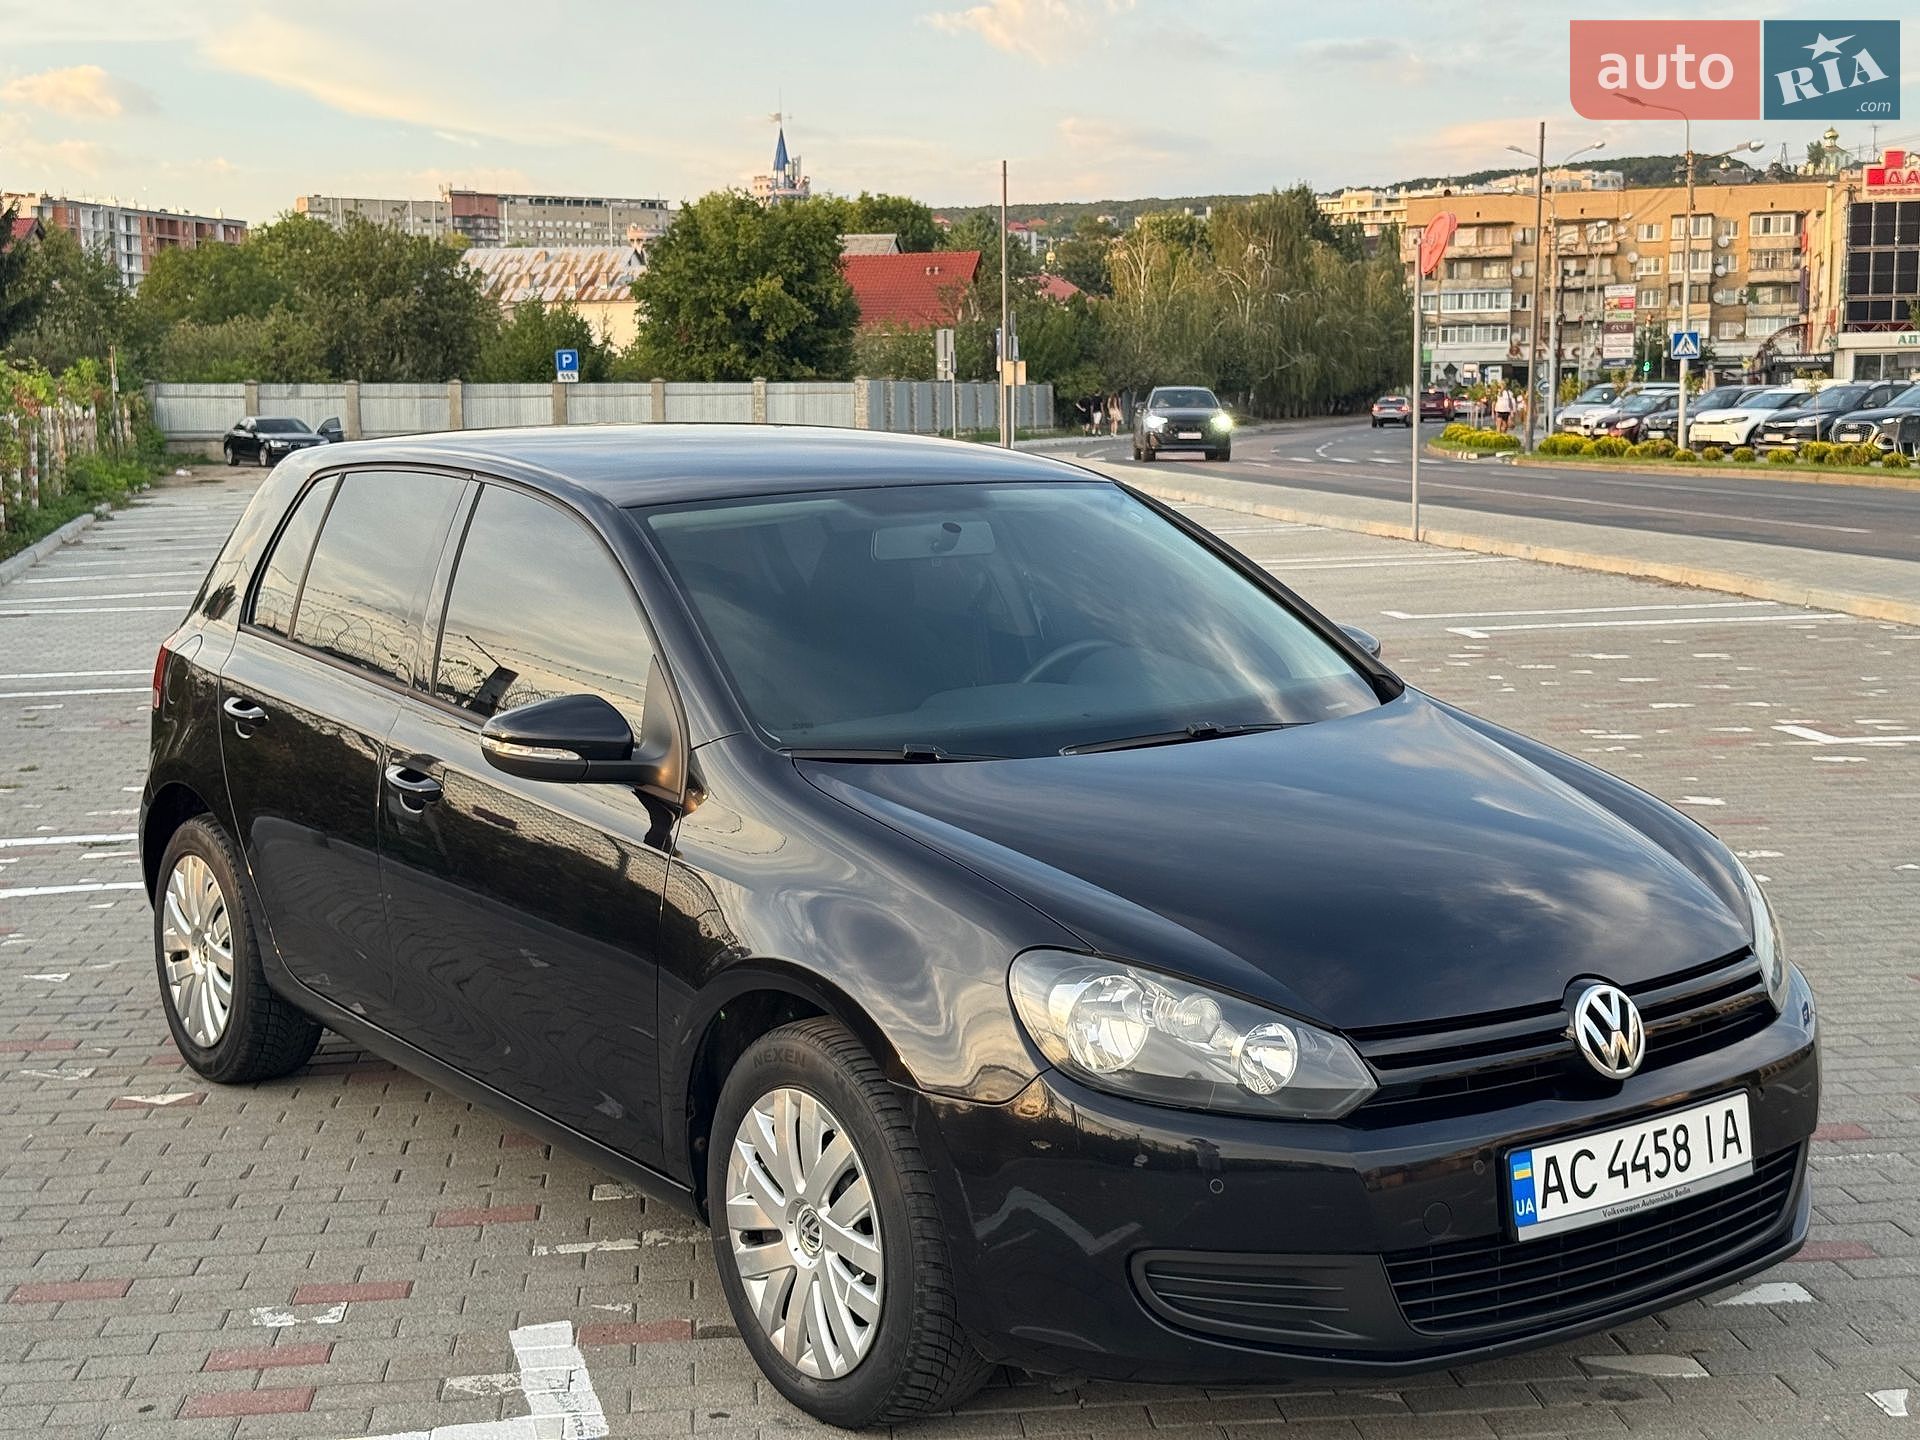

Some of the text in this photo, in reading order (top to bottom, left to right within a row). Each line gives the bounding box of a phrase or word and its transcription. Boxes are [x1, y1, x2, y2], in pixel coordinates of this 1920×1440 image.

[562, 354, 573, 368] P
[752, 1047, 807, 1069] NEXEN
[1541, 1108, 1743, 1209] AC 4458 IA
[1516, 1199, 1535, 1216] UA
[1601, 1202, 1640, 1218] Volkswagen
